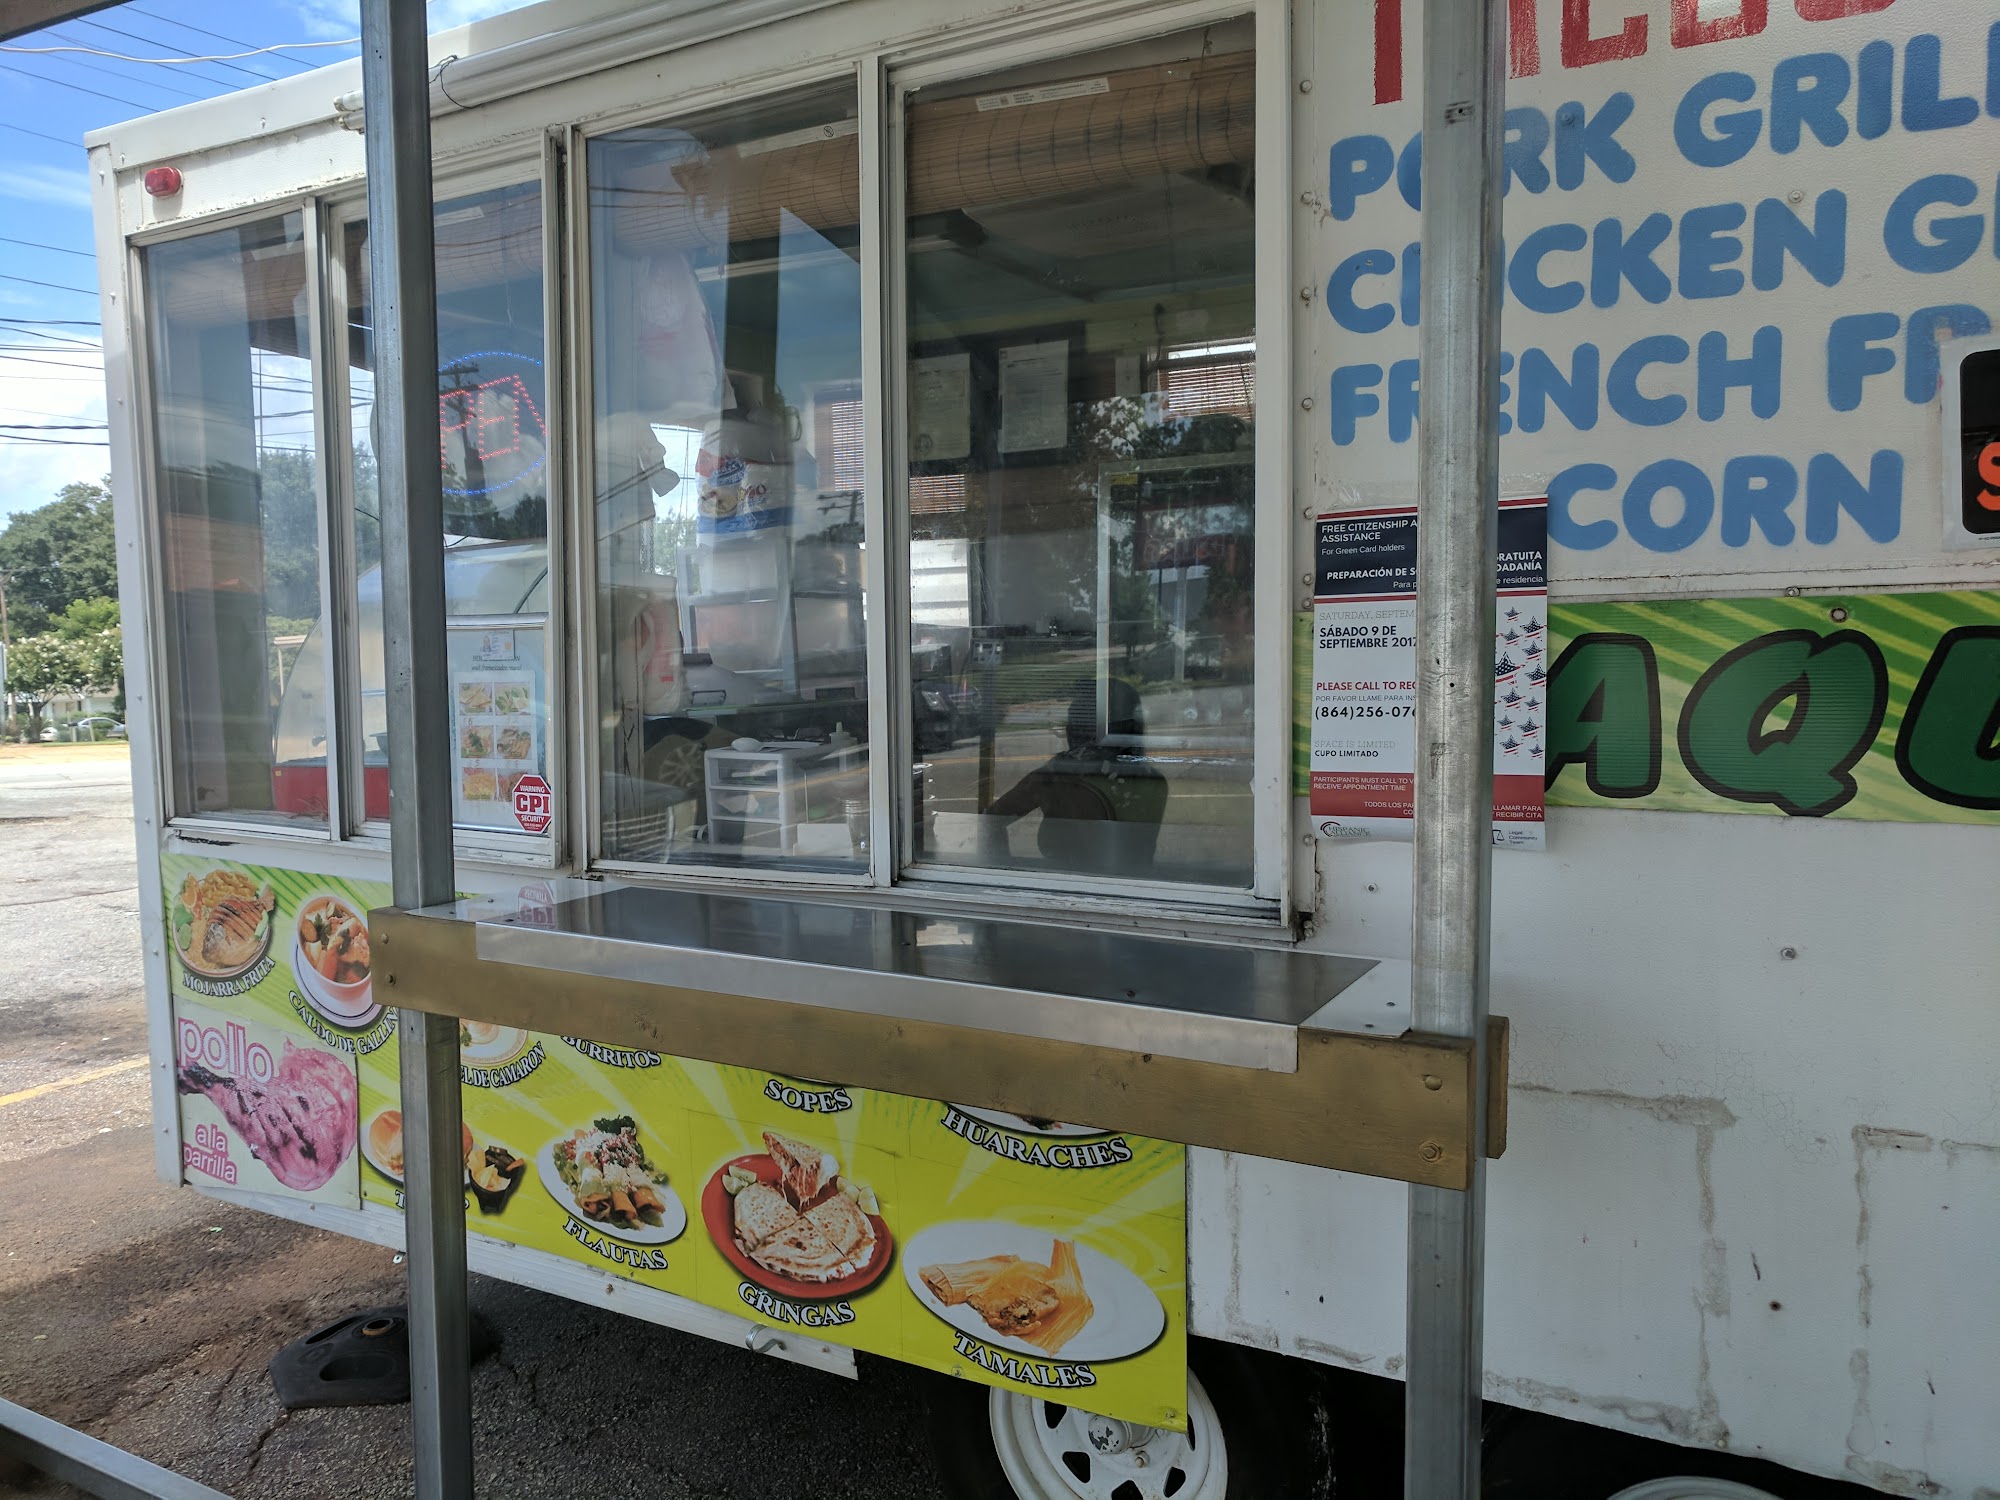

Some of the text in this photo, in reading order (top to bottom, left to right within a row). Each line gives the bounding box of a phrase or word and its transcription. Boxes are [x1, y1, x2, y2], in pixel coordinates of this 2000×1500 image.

[1672, 20, 2000, 168] GRIL
[1326, 188, 1848, 334] CCKEN
[1546, 448, 1904, 553] CORN
[1321, 523, 1346, 533] FREE
[1347, 520, 1409, 532] CITIZENSHIP
[1321, 532, 1381, 543] ASSISTANCE
[1321, 543, 1405, 556] For Green Card holders
[1497, 551, 1542, 561] RATUITA
[1326, 566, 1393, 580] PREPARACIÓN
[1395, 568, 1407, 577] DE
[1502, 576, 1544, 584] residencia
[1319, 611, 1373, 620] SATURDAY,
[1319, 624, 1396, 637] SÁBADO 9 DE
[1319, 637, 1388, 649] SEPTIEMBRE
[1316, 681, 1352, 691] PLEASE
[1355, 681, 1380, 690] CALL
[1383, 681, 1397, 690] TO
[1314, 740, 1343, 748] SPACE
[1357, 741, 1396, 749] LIMITED
[1339, 750, 1379, 758] LIMITADO
[520, 785, 545, 793] WARNING
[515, 793, 550, 814] CPI
[521, 815, 545, 823] SECURITY
[182, 955, 276, 997] MOJARRA FRITA
[288, 990, 337, 1047] CALDO
[337, 1034, 356, 1056] DE
[177, 1017, 275, 1084] pollo
[560, 1035, 662, 1068] BURRITOS
[473, 1068, 490, 1088] DE
[490, 1040, 548, 1088] CAMARON
[764, 1078, 853, 1113] SOPES
[940, 1107, 1133, 1170] HUARACHES
[183, 1146, 236, 1183] parrilla
[562, 1216, 669, 1272] FLAUTAS
[738, 1281, 856, 1328] GRINGAS
[952, 1330, 1098, 1389] TAMALES
